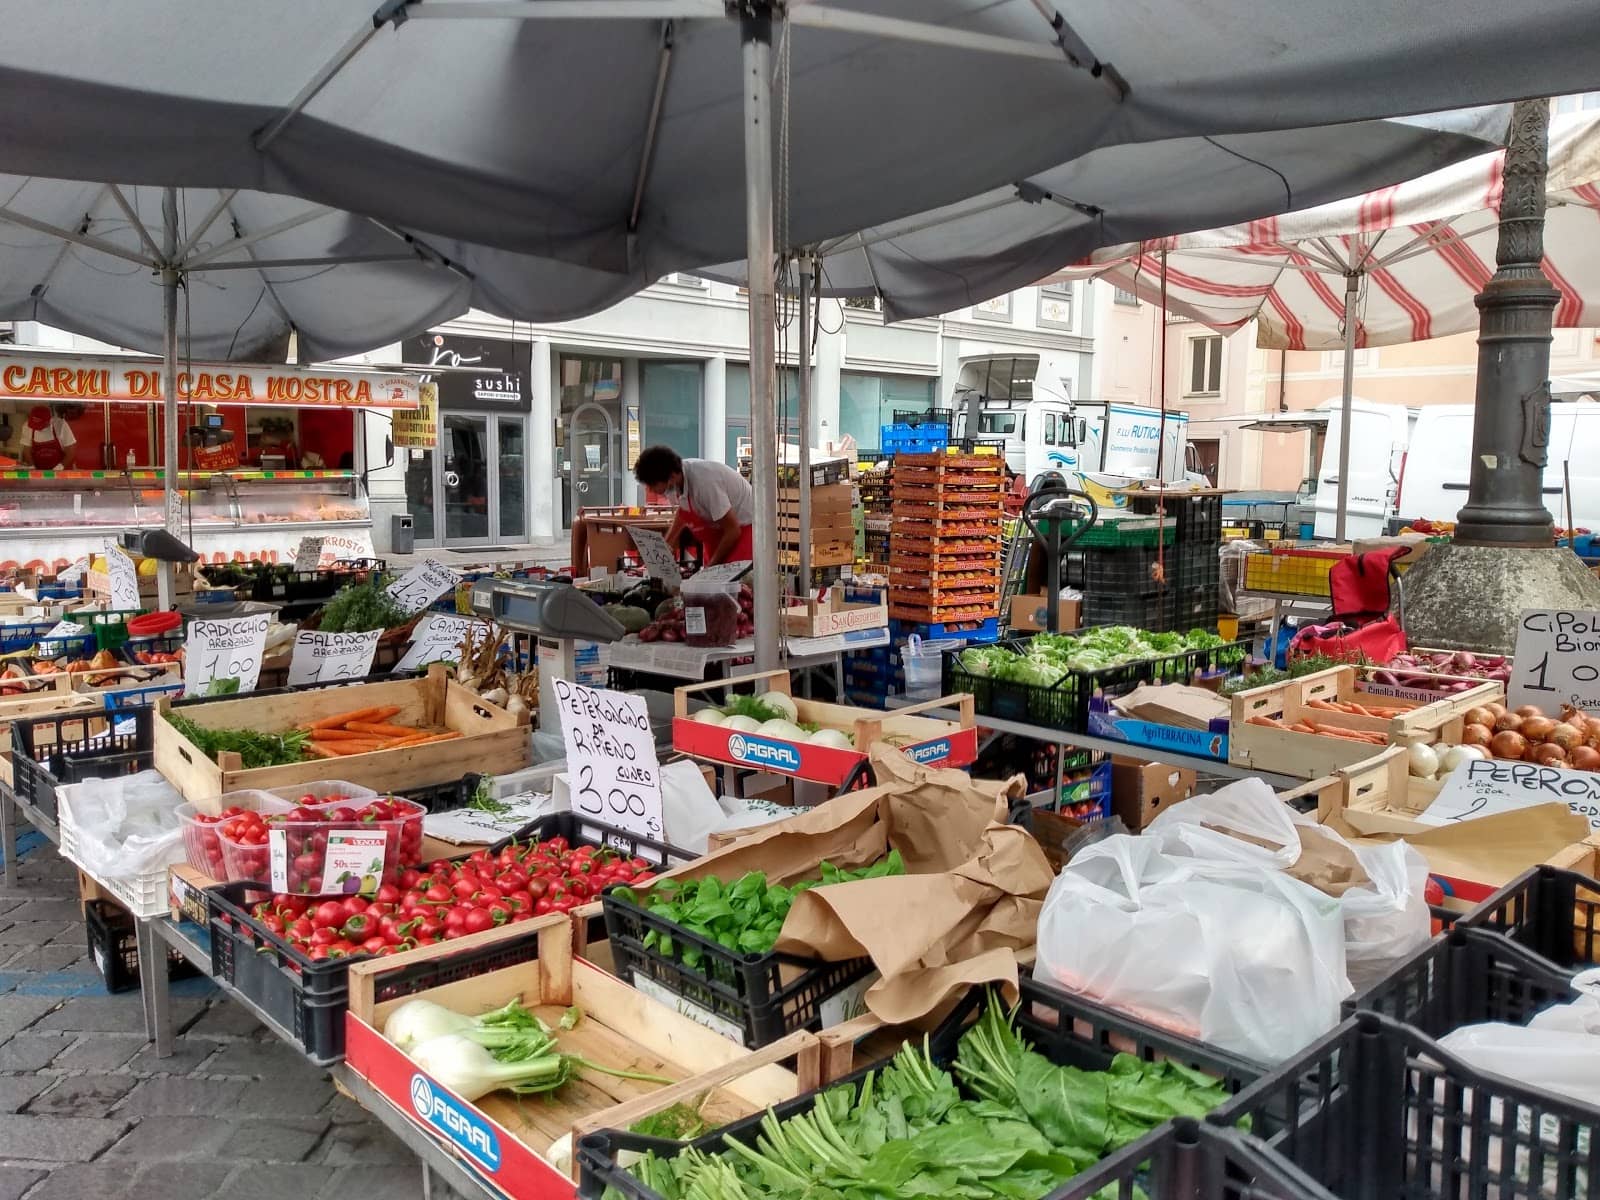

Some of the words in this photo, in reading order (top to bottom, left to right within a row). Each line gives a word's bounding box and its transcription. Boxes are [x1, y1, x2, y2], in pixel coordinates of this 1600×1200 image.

[3, 365, 110, 397] CARNI
[124, 370, 160, 398] DI
[176, 372, 255, 400] CASA
[267, 376, 373, 404] NOSTRA
[475, 376, 520, 392] sushi
[1394, 687, 1418, 700] Rossa
[1419, 693, 1427, 702] di
[746, 742, 799, 765] AGRAL
[913, 743, 950, 762] AGRAL
[617, 765, 652, 782] CUNEO
[433, 1096, 498, 1162] AGRAL
